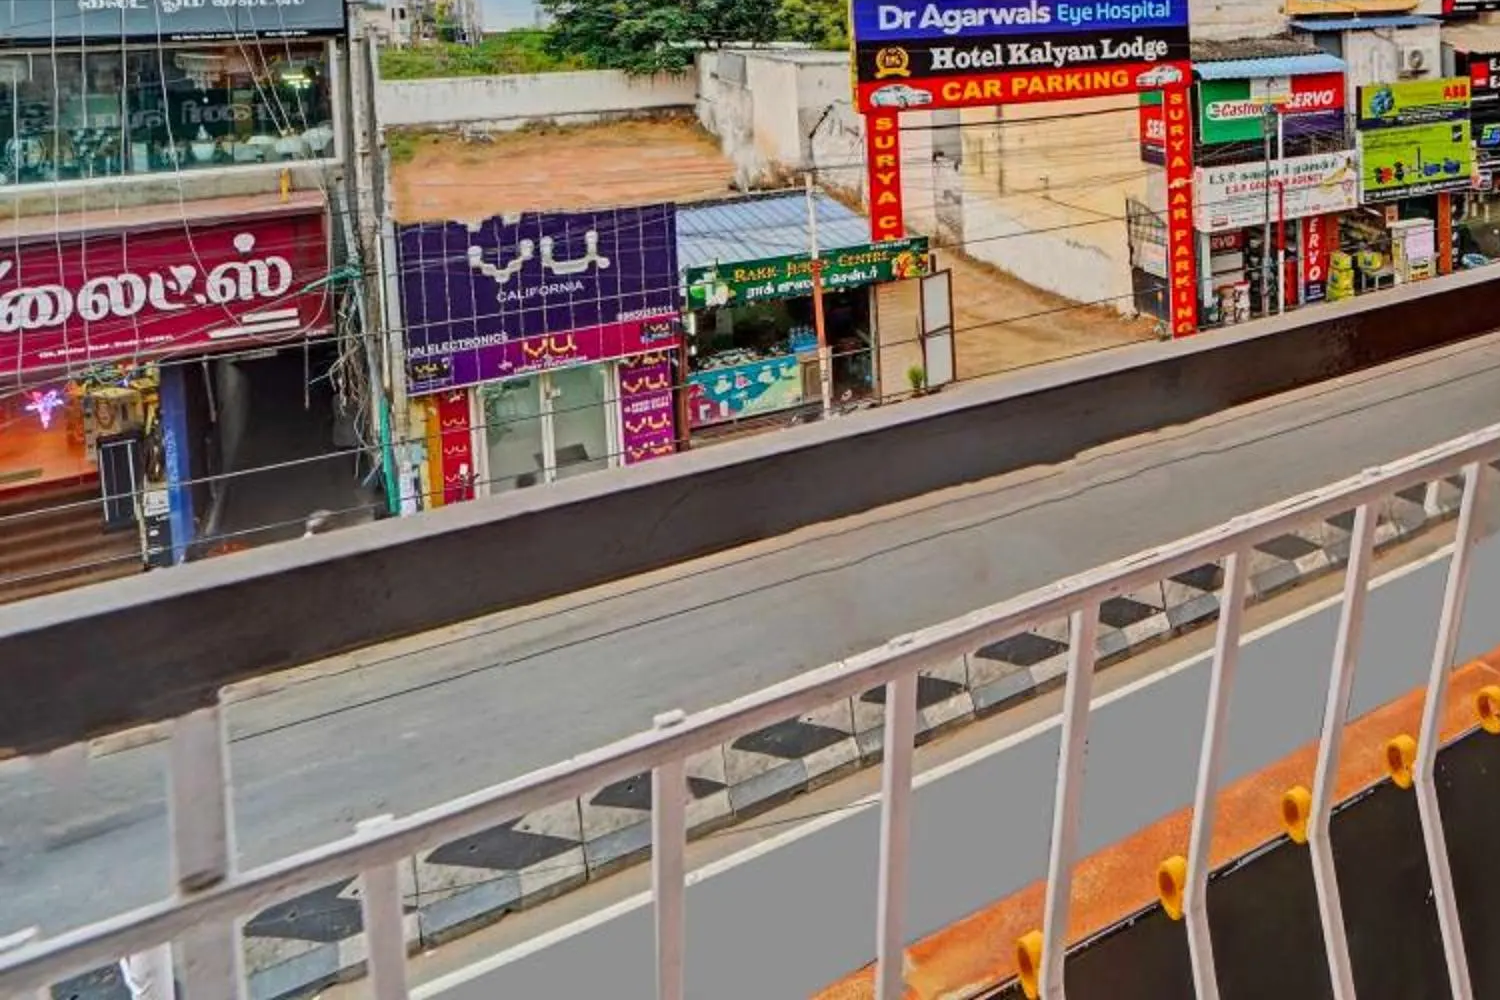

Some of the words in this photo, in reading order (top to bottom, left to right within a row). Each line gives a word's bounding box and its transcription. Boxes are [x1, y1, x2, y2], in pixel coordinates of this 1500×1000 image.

[878, 4, 916, 31] Dr
[918, 0, 1051, 34] Agarwals
[1056, 2, 1093, 26] Eye
[1095, 0, 1171, 21] Hospital
[929, 43, 1003, 71] Hotel
[1006, 39, 1097, 69] Kalyan
[1099, 35, 1168, 61] Lodge
[942, 81, 1002, 102] CAR
[1011, 69, 1130, 97] PARKING
[1285, 89, 1335, 109] SERVO
[496, 279, 586, 303] CALIFORNIA
[1173, 230, 1193, 334] PARKING
